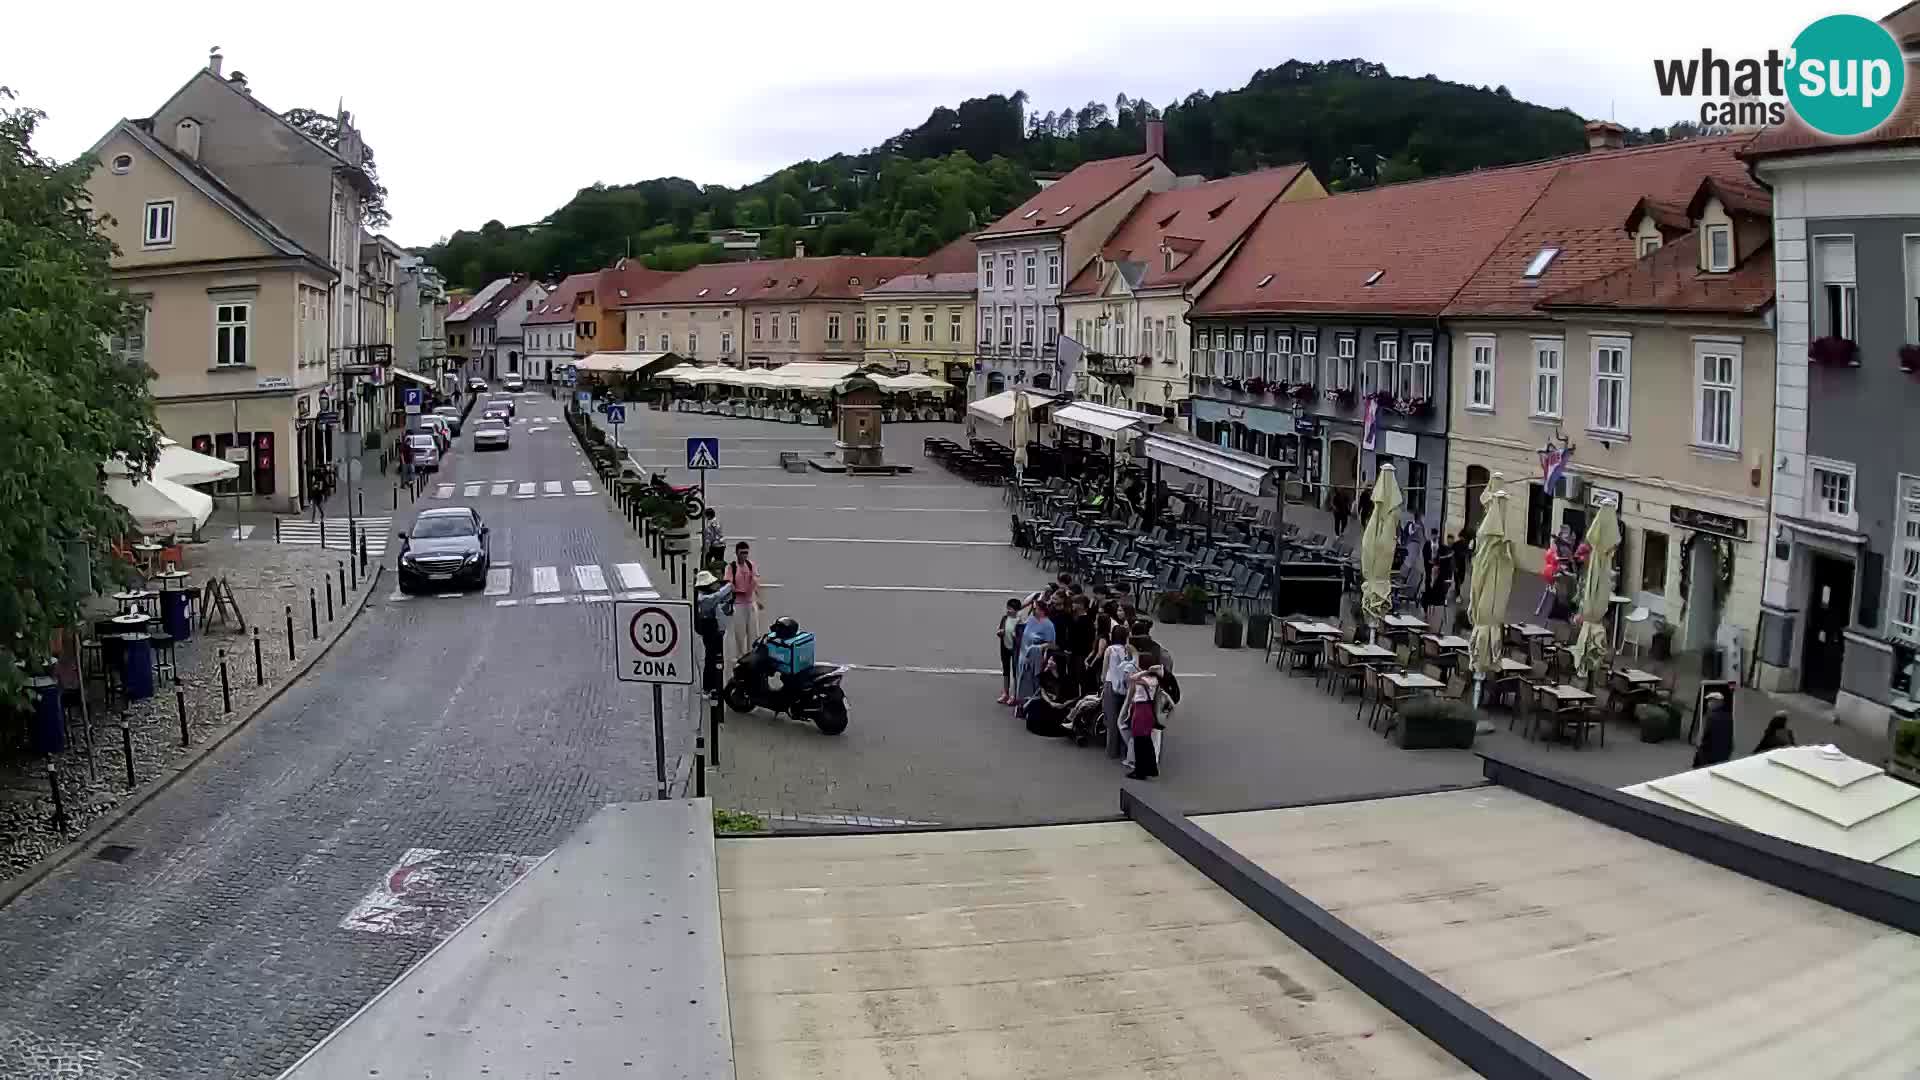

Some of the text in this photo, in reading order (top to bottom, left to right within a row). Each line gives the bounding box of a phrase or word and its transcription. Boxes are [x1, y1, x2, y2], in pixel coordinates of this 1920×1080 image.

[408, 391, 417, 403] P
[643, 623, 666, 644] 30
[632, 660, 677, 677] ZONA
